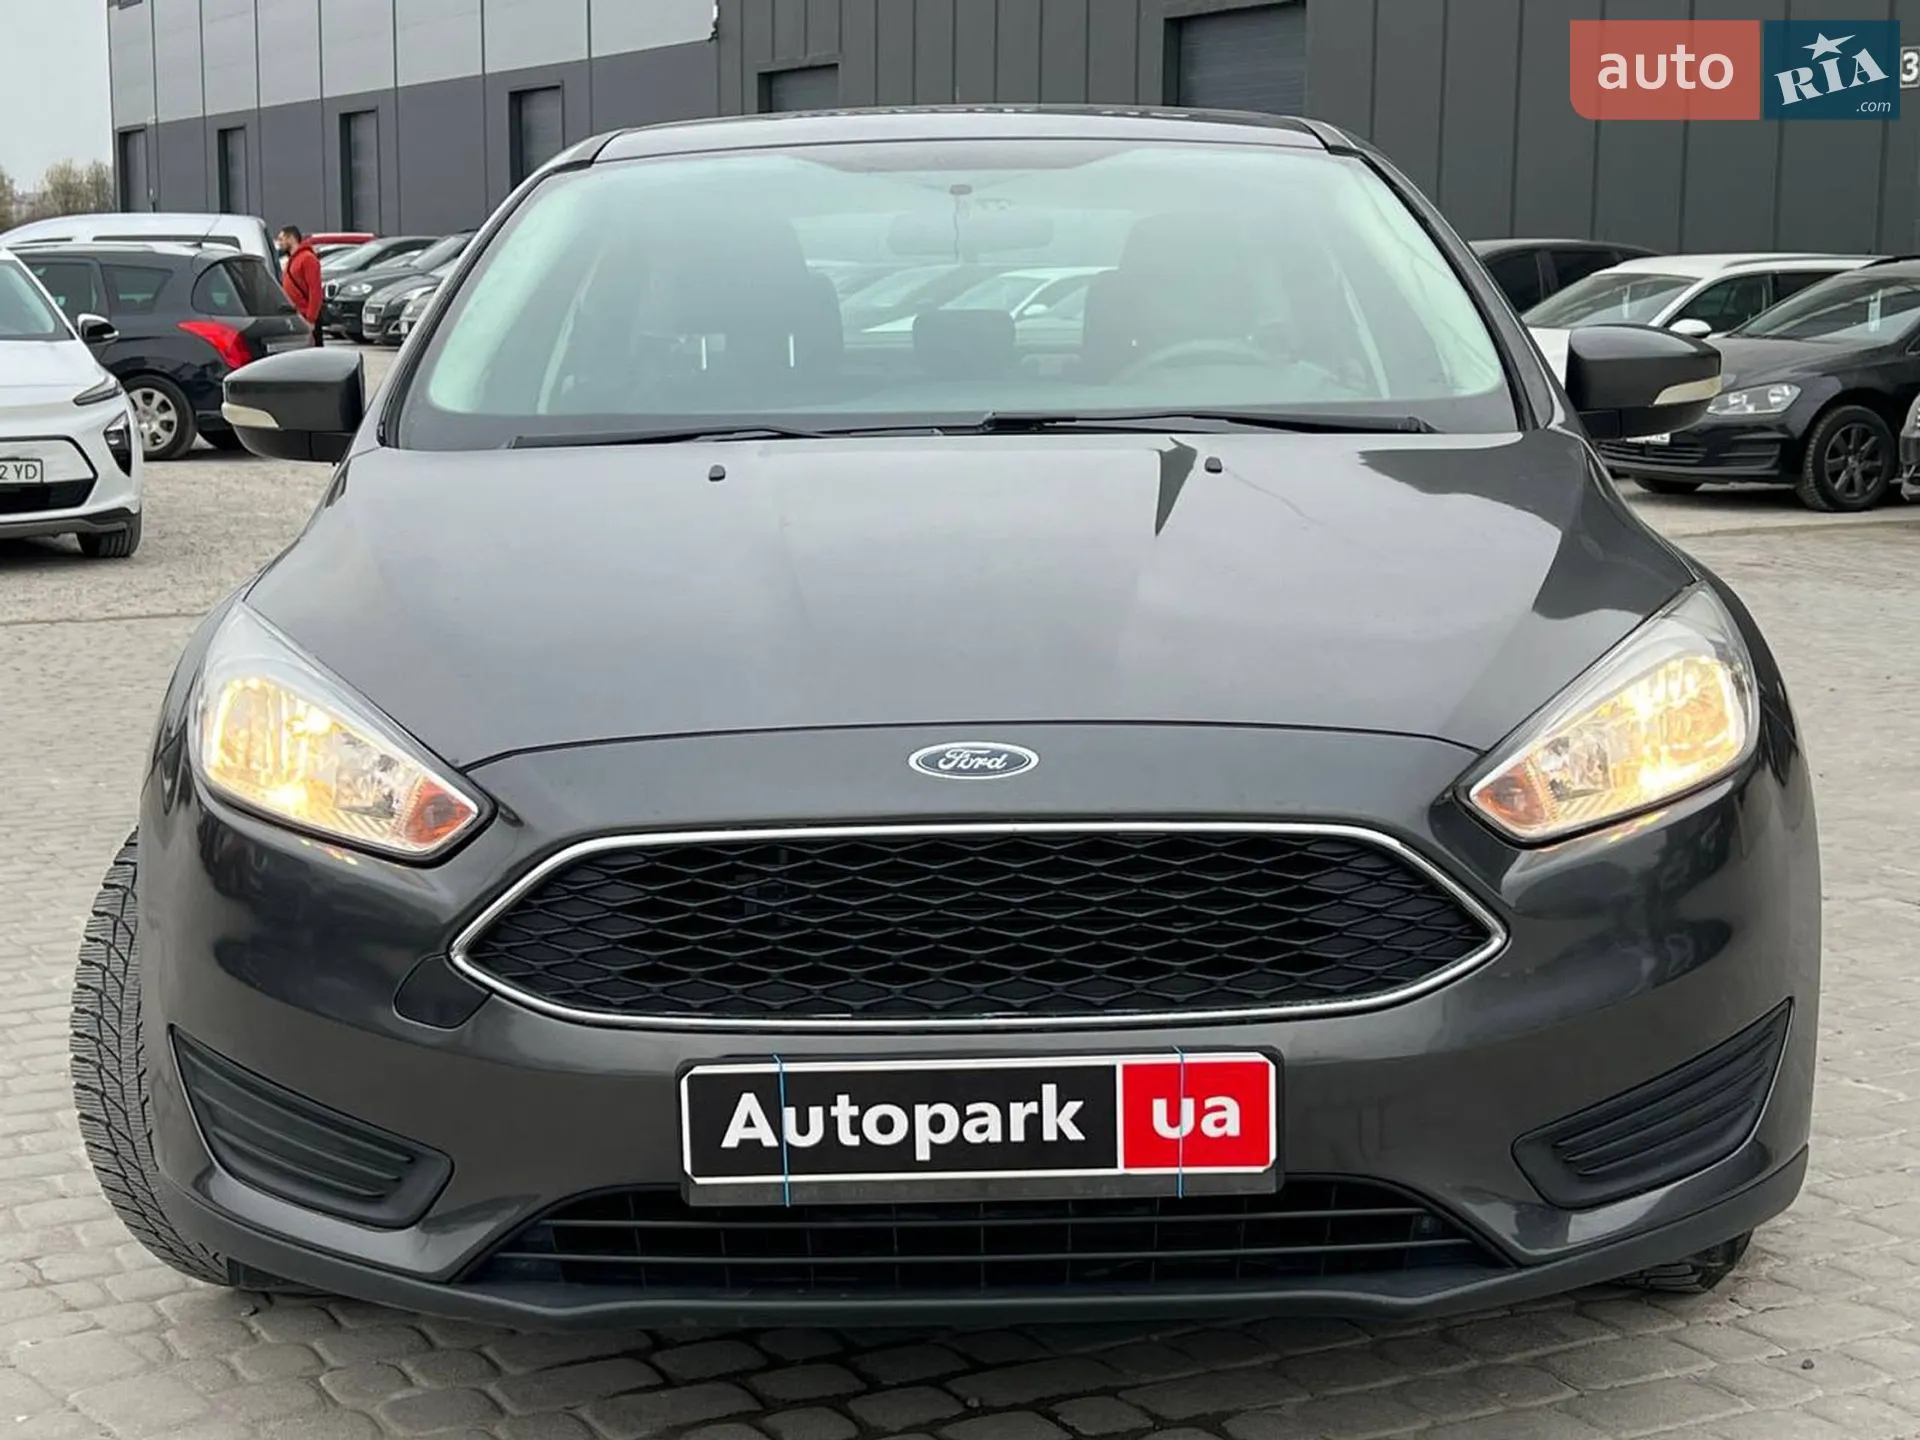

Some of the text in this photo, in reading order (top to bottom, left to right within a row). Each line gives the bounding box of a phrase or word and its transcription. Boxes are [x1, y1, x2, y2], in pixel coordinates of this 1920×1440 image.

[1901, 51, 1919, 82] 3
[13, 464, 38, 480] YD
[937, 748, 1009, 771] Ford
[720, 1083, 1242, 1162] Autopark ua
